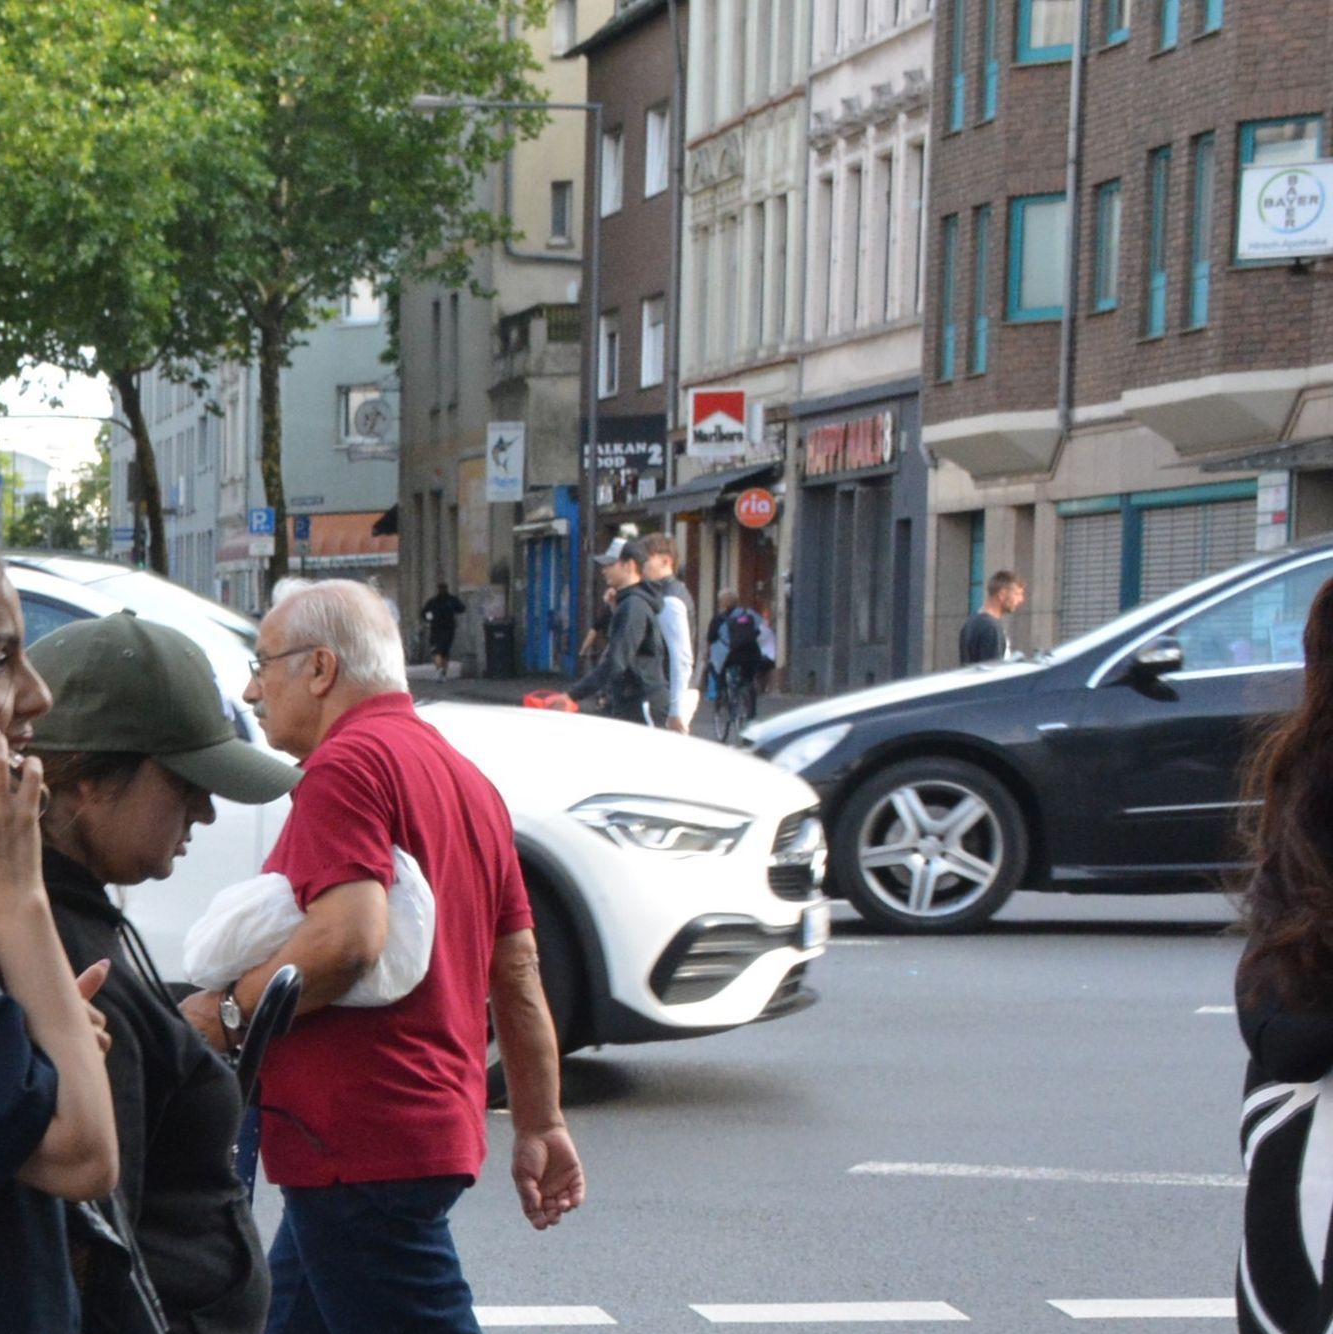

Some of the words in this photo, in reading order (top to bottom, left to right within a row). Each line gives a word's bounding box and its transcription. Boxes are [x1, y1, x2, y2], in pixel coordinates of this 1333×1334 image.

[1264, 195, 1319, 208] BAYER
[693, 425, 744, 443] Marlboro
[647, 443, 663, 466] 2
[740, 495, 771, 514] ria
[252, 511, 267, 532] P
